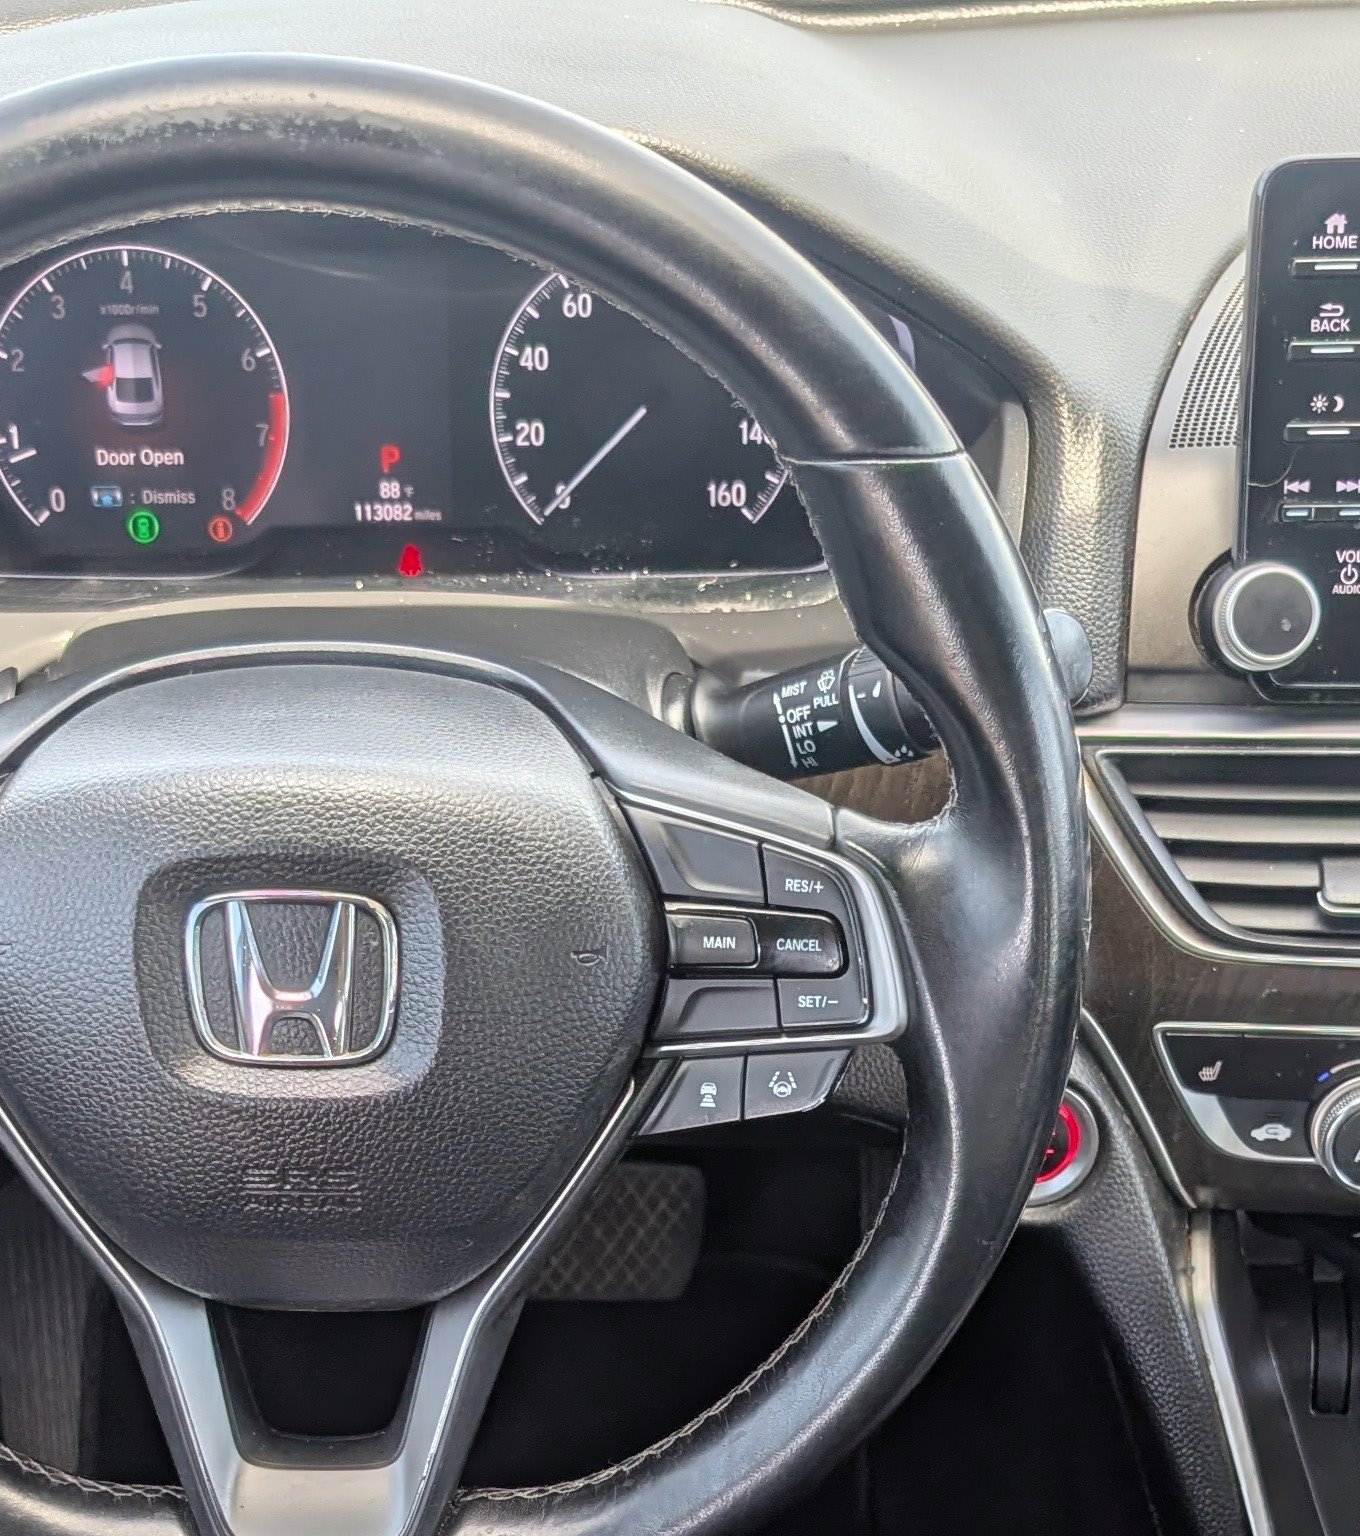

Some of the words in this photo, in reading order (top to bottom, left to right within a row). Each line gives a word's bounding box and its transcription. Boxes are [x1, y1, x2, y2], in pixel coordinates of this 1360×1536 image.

[1312, 235, 1359, 249] HOME
[120, 271, 133, 294] 4
[52, 295, 66, 319] 3
[193, 294, 207, 318] 5
[561, 292, 593, 318] 60
[1310, 319, 1351, 333] BACK
[11, 349, 24, 372] 2
[241, 350, 256, 371] 6
[518, 346, 550, 371] 40
[8, 424, 19, 450] 1
[256, 423, 270, 447] 7
[515, 421, 545, 447] 20
[95, 449, 136, 466] Door
[141, 449, 185, 468] Open
[381, 444, 401, 474] P
[50, 488, 65, 512] 0
[142, 487, 196, 505] Dismiss
[222, 487, 236, 511] 8
[379, 480, 400, 499] 88
[707, 482, 747, 508] 160
[354, 502, 413, 521] 113082
[781, 681, 808, 699] MIST
[812, 692, 839, 710] PULL
[786, 704, 811, 724] OFF
[792, 721, 813, 739] INT
[797, 739, 817, 756] LO
[702, 936, 737, 950] MAIN
[776, 938, 823, 952] CANCEL
